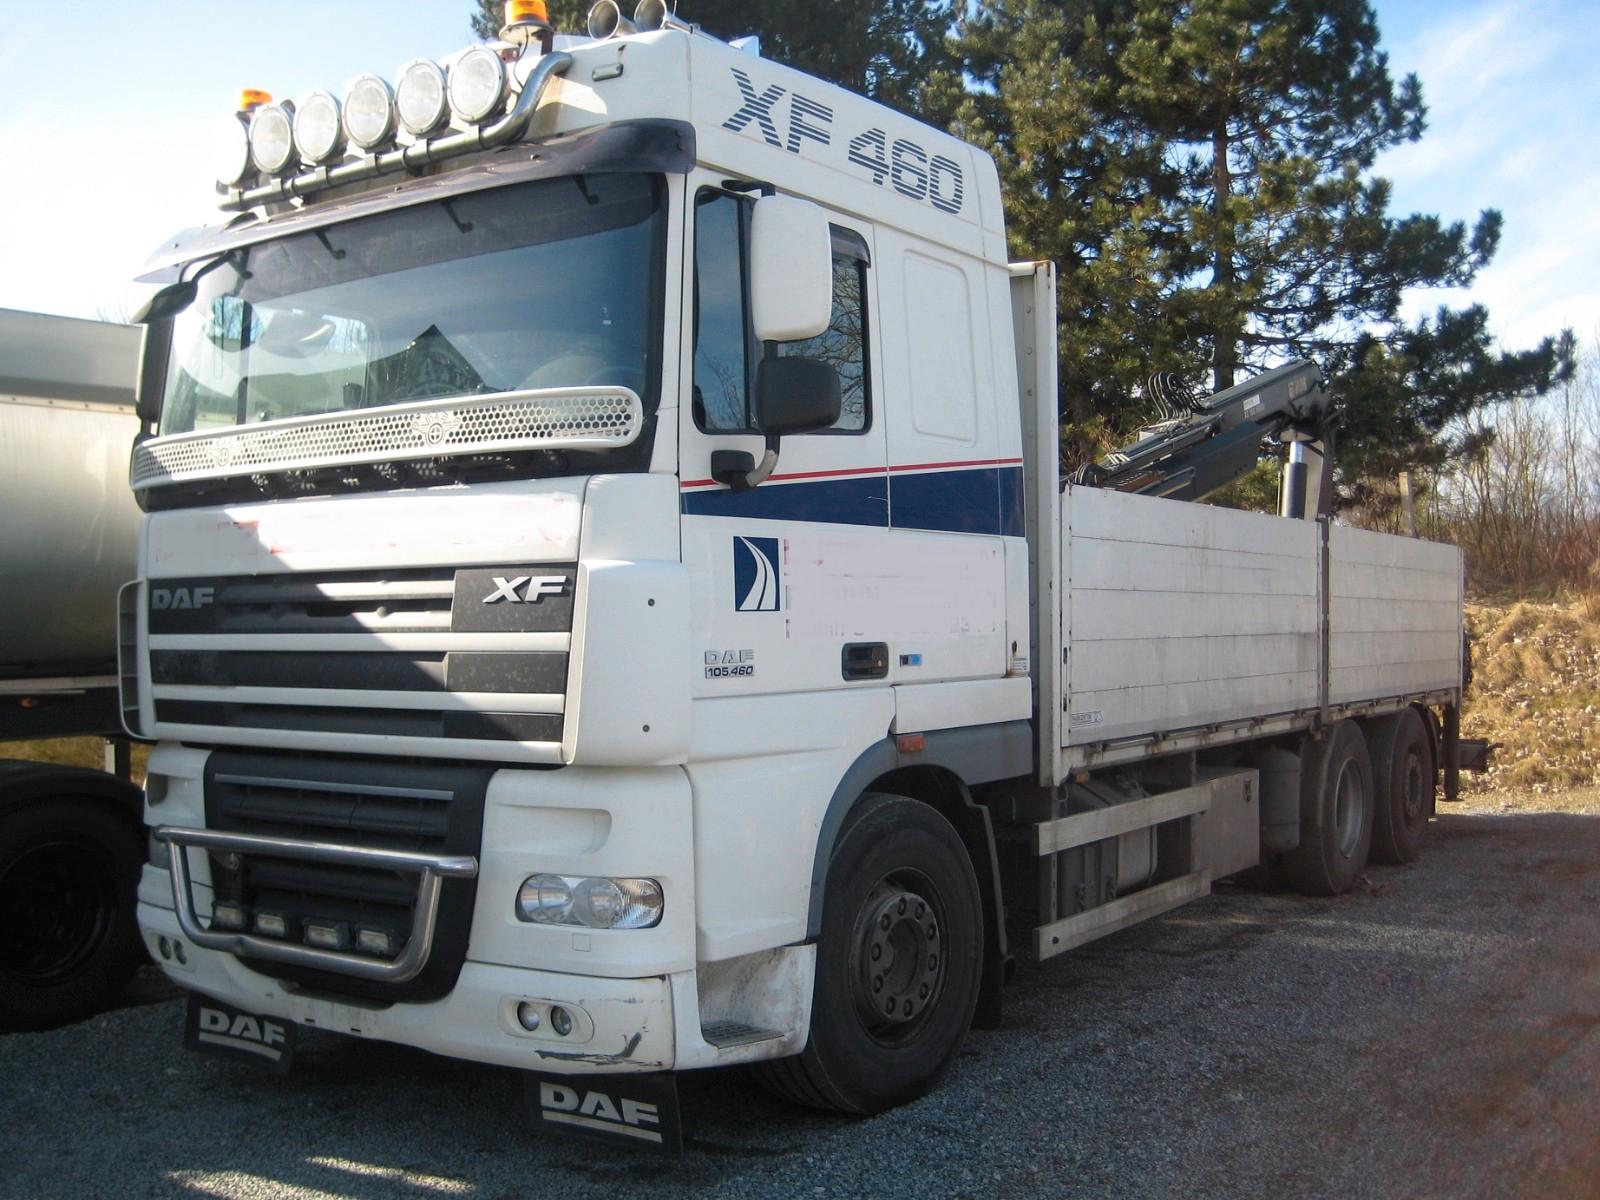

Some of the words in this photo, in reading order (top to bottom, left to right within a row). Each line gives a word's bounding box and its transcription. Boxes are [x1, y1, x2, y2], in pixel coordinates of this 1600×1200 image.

[721, 67, 834, 154] XF
[848, 128, 963, 215] 460
[152, 587, 216, 610] DAF
[482, 575, 568, 604] XF
[704, 649, 755, 665] DAF
[706, 666, 754, 677] 105.460
[199, 1007, 285, 1045] DAF
[540, 1081, 660, 1124] DAF
